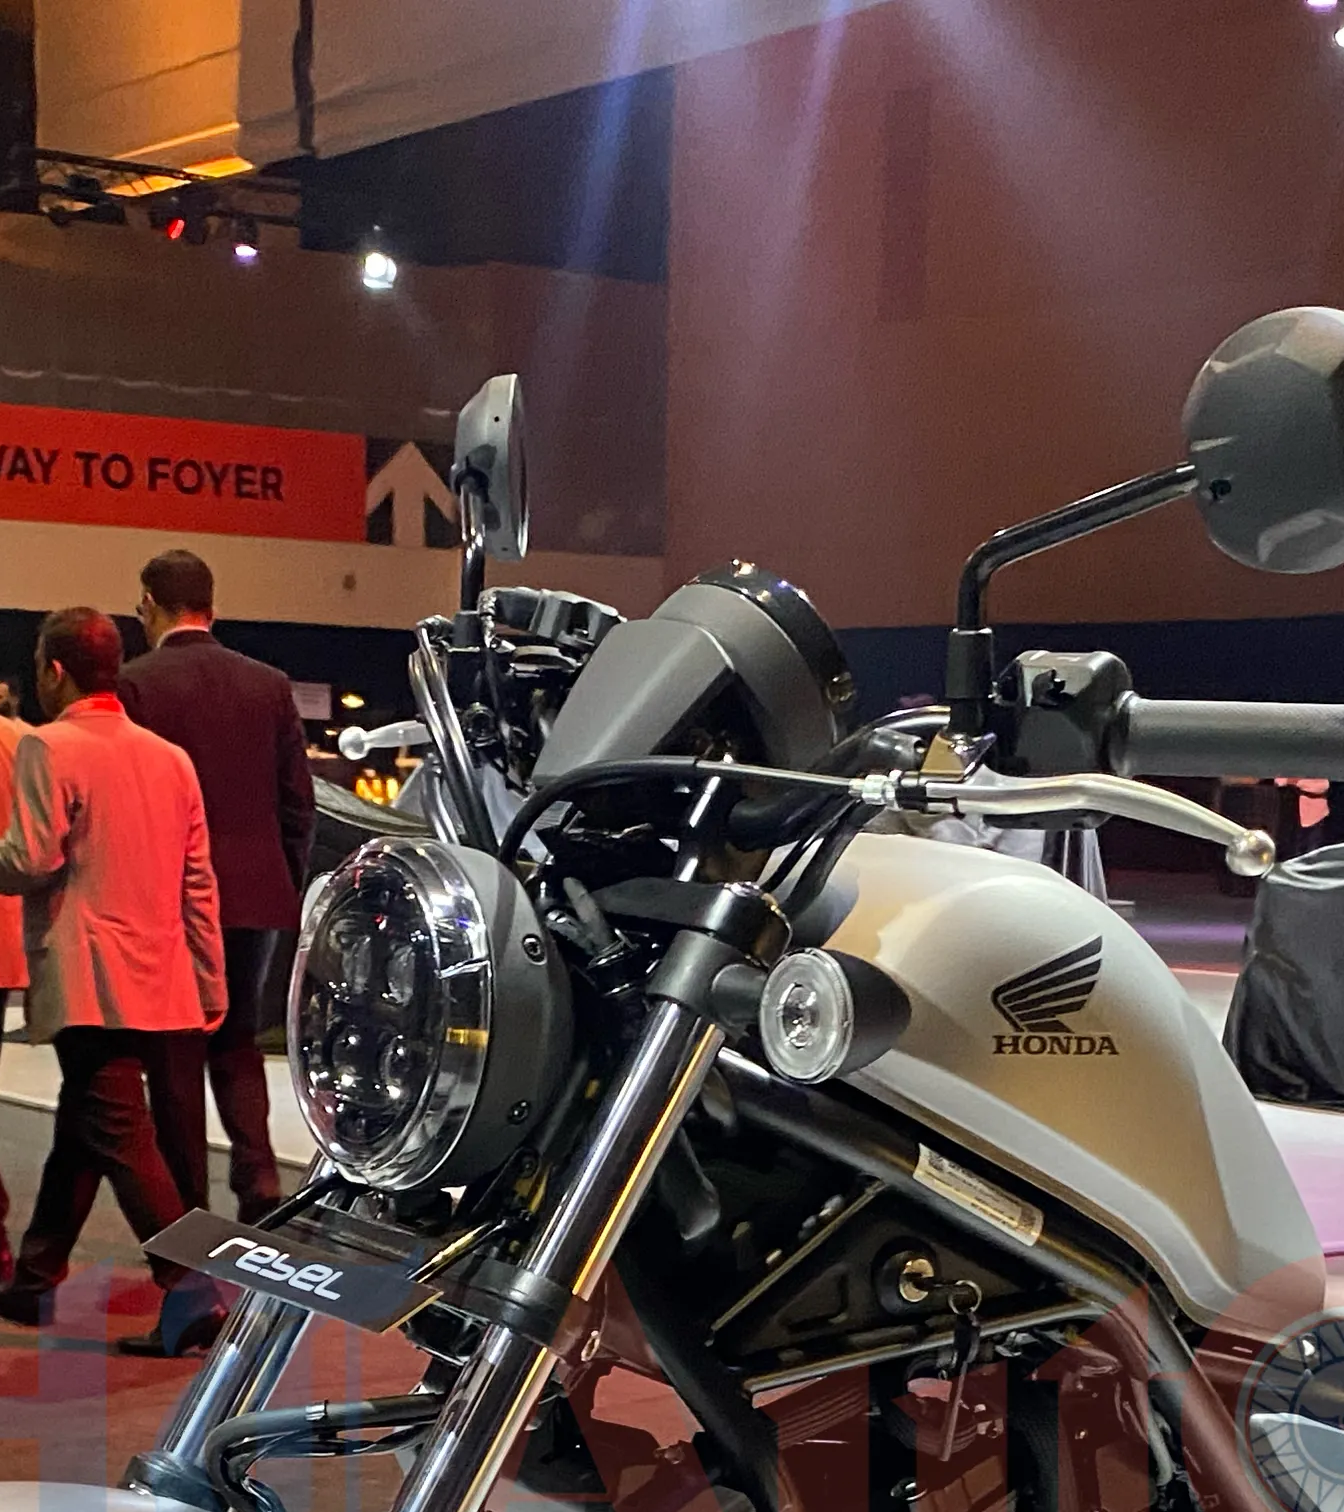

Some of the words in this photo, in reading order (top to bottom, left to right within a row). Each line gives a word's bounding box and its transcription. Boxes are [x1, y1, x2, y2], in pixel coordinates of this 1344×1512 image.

[74, 450, 135, 491] TO
[146, 456, 285, 502] FOYER
[992, 1034, 1120, 1056] HONDA
[207, 1236, 344, 1301] rebel
